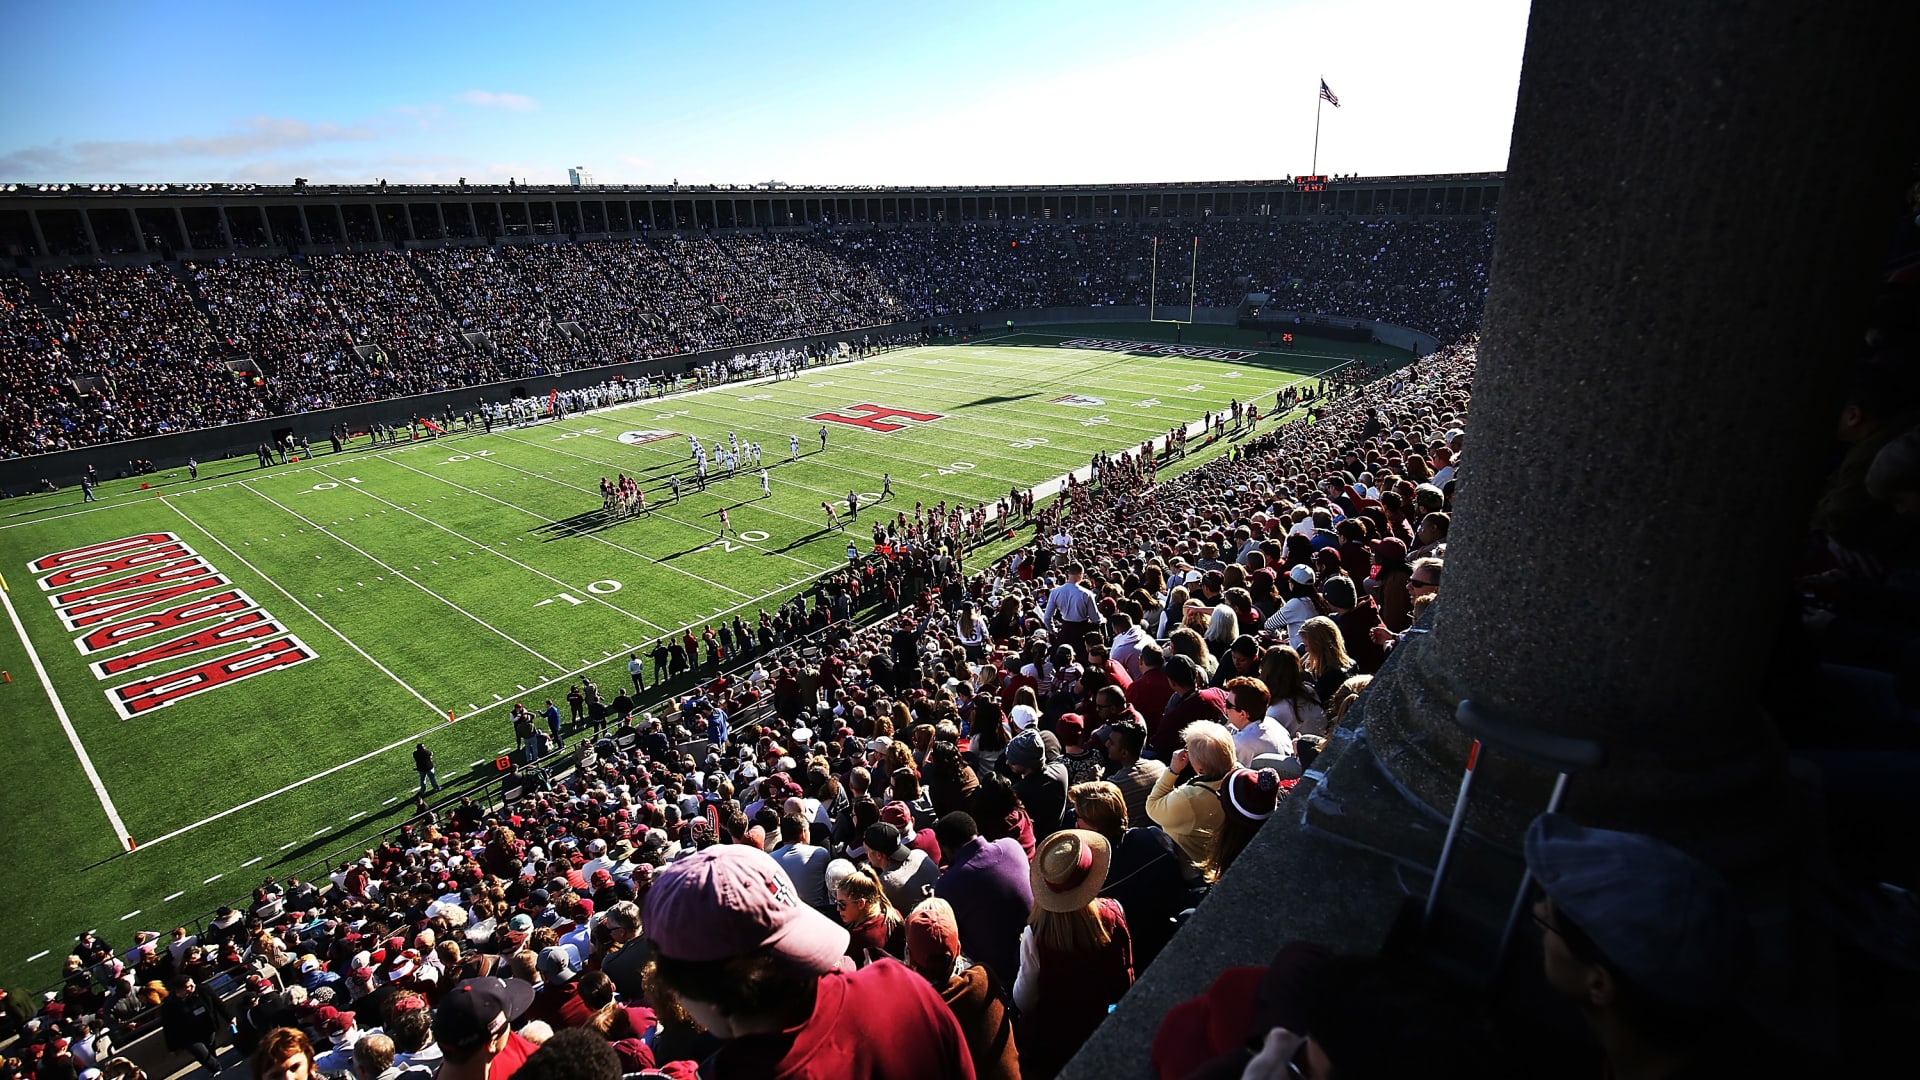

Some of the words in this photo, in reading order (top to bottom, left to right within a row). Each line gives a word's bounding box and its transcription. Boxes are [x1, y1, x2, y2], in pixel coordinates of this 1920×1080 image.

[1283, 333, 1292, 342] 25
[801, 401, 950, 435] H
[1008, 438, 1049, 449] 50
[448, 449, 496, 462] 20
[937, 462, 976, 476] 40
[706, 530, 770, 554] 20
[552, 580, 622, 606] 10
[26, 531, 320, 721] HARVARD
